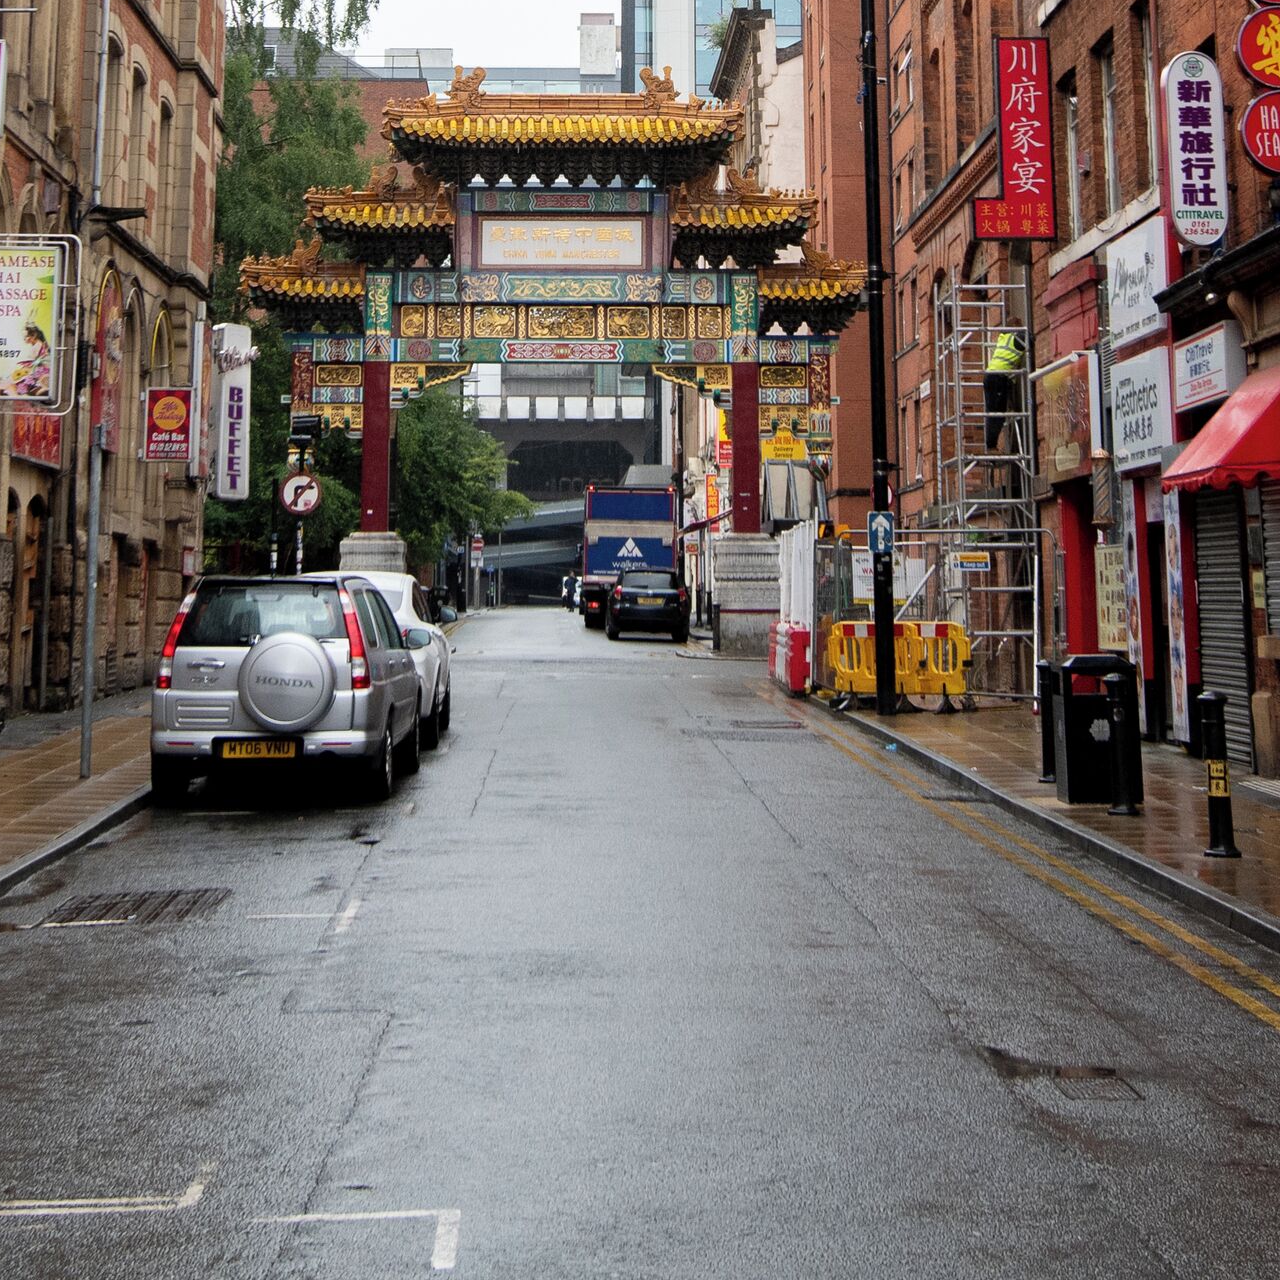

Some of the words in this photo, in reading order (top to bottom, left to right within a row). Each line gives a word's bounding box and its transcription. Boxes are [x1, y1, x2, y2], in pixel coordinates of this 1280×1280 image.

[1177, 80, 1218, 207] 新華旅行社
[1175, 209, 1225, 220] CITITRAVEL
[1184, 228, 1199, 236] 236
[1115, 377, 1158, 420] Aesthetics
[226, 385, 244, 491] BUFFET
[255, 675, 315, 689] HONDA
